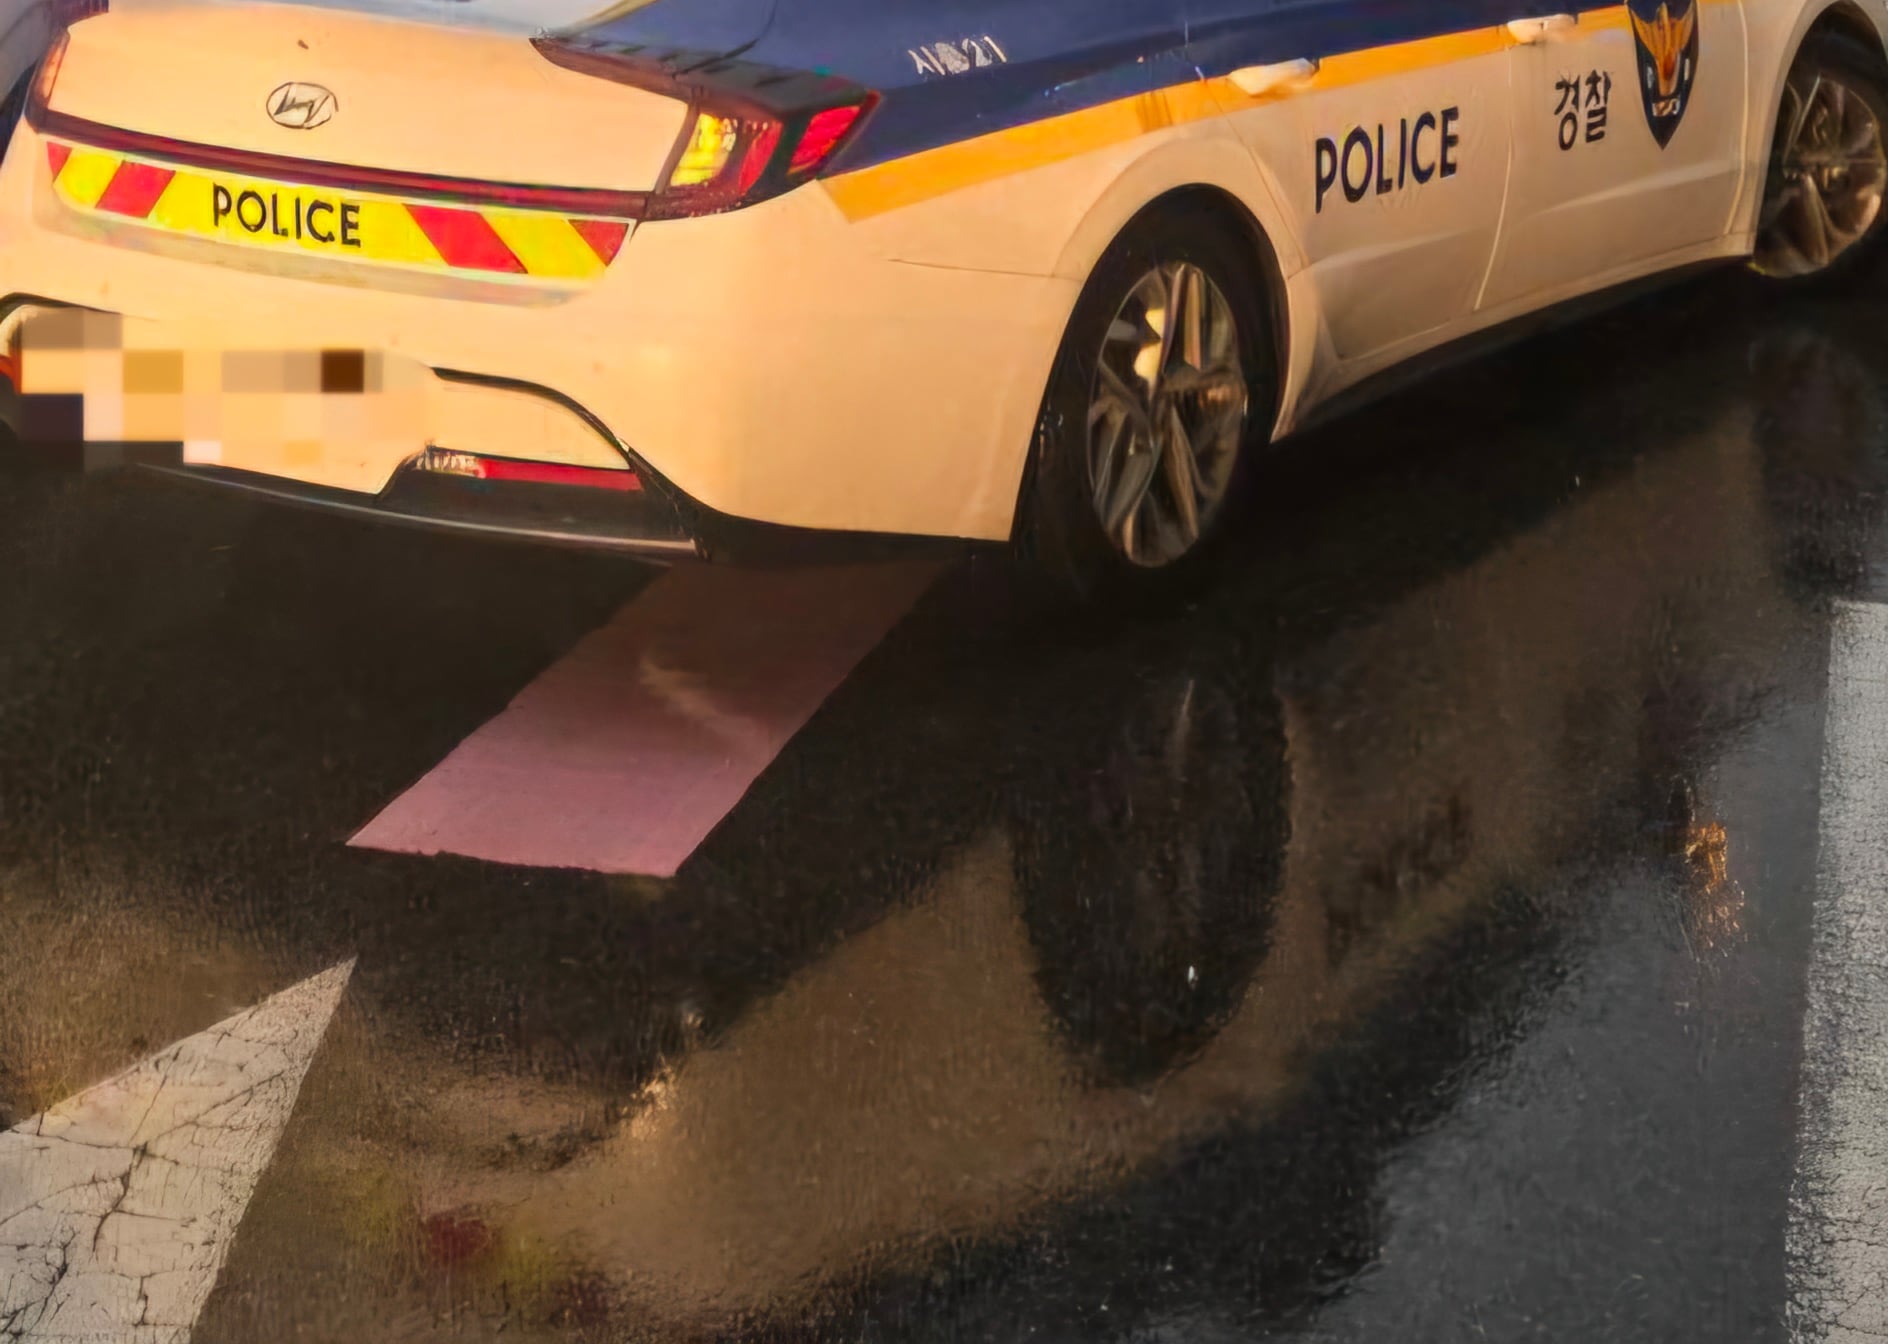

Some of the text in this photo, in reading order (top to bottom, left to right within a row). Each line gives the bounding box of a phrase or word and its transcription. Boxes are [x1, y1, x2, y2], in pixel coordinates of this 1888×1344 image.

[1554, 69, 1612, 151] 경찰
[1315, 106, 1459, 215] POLICE
[212, 182, 362, 248] POLICE
